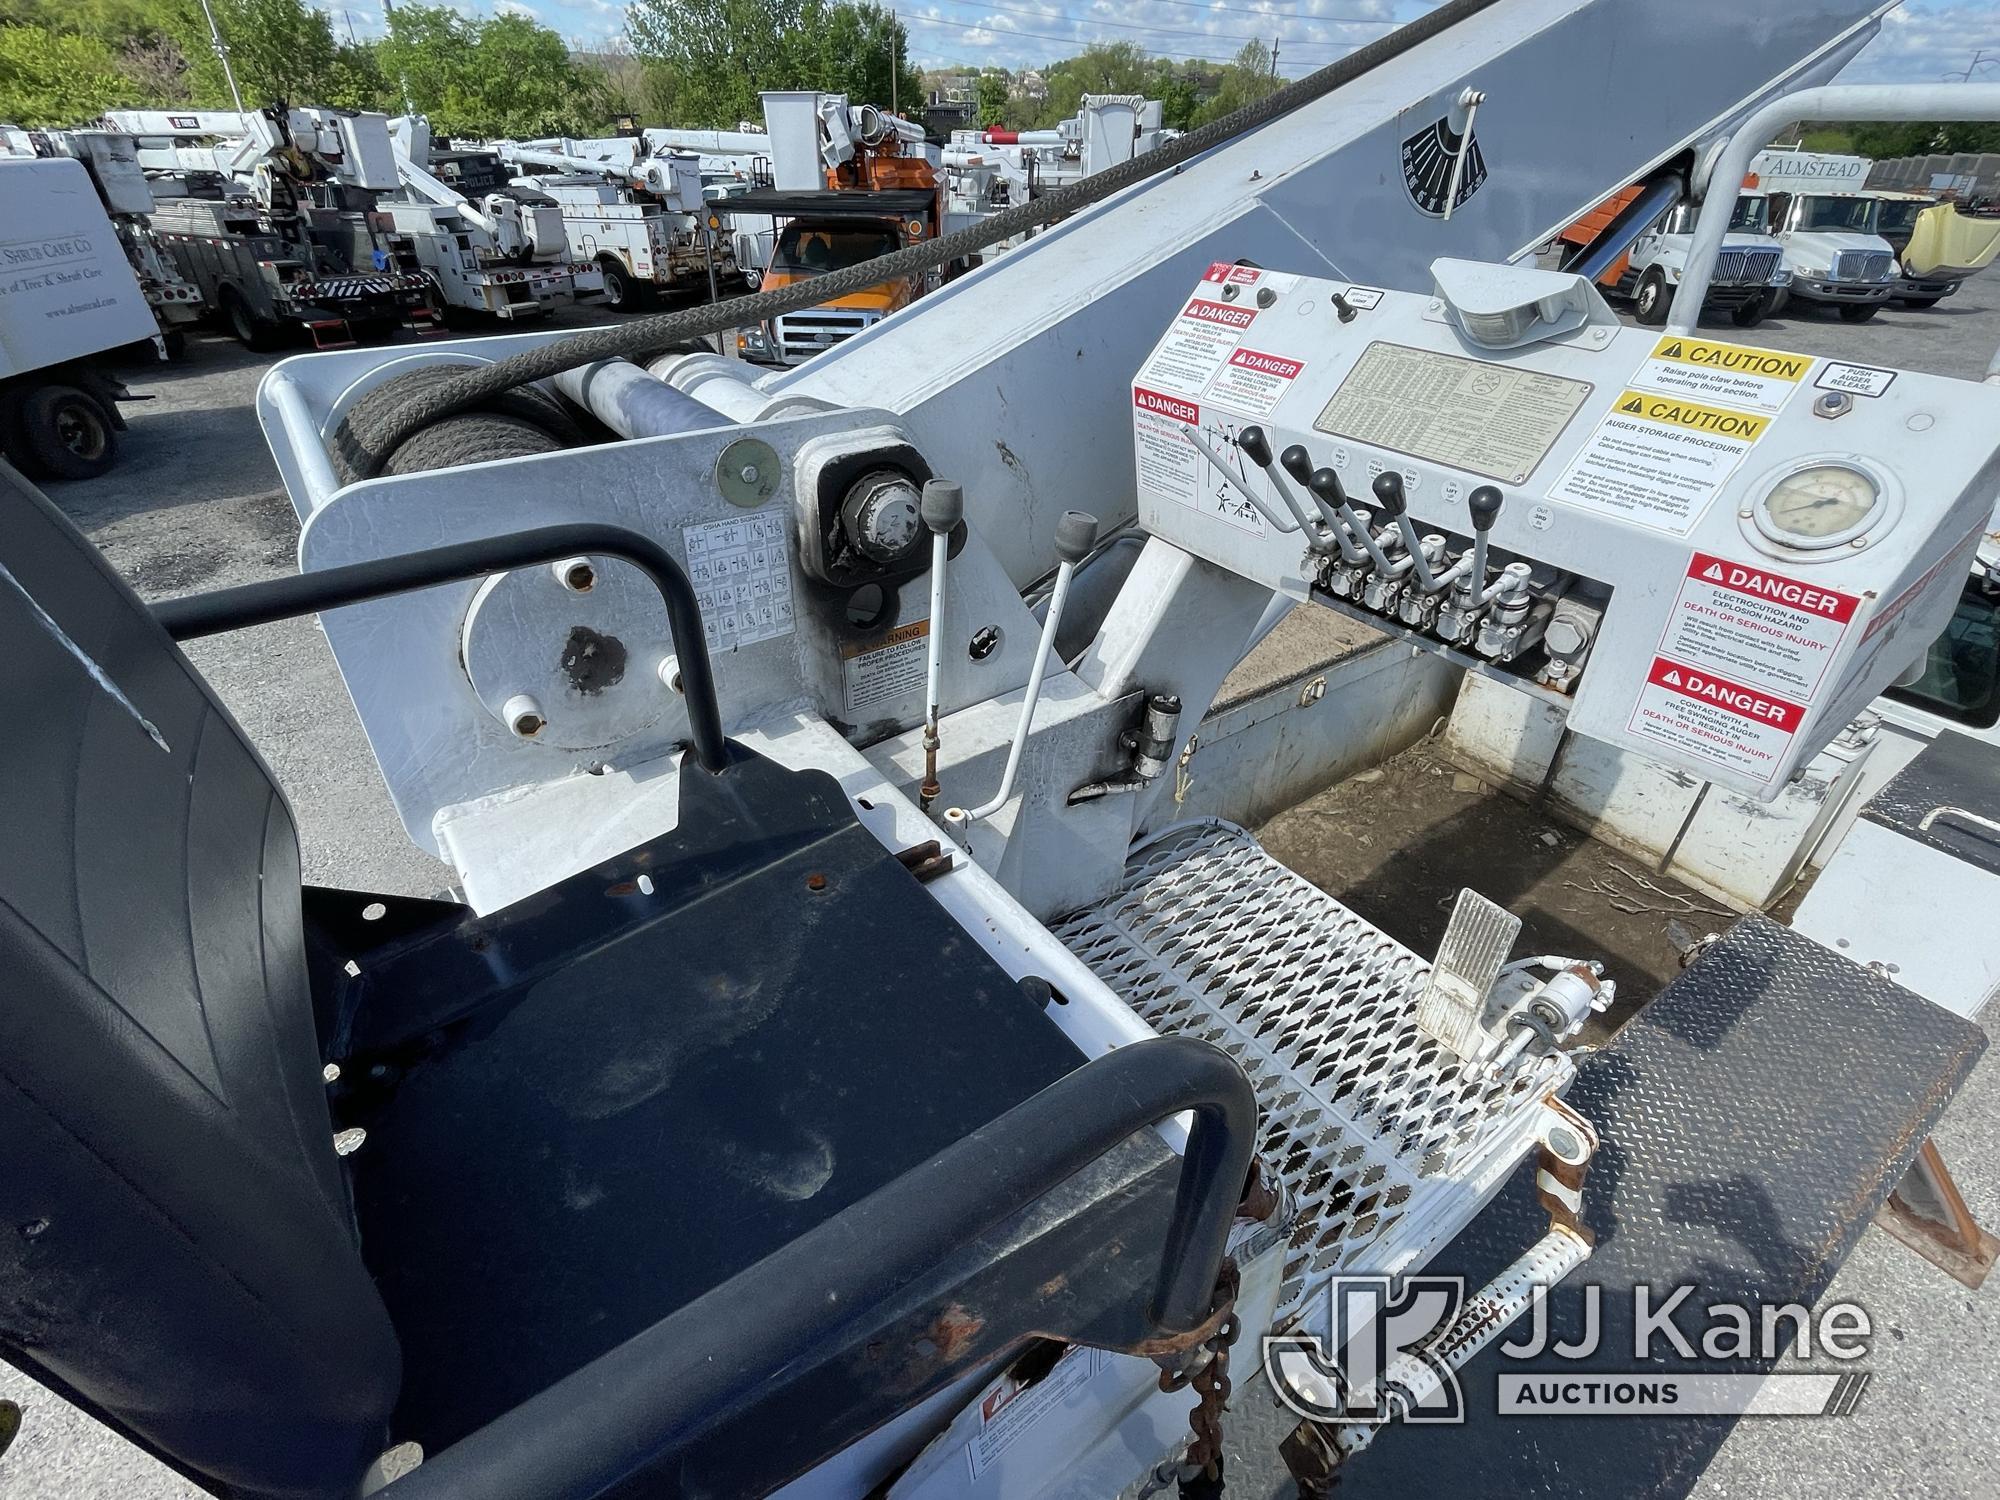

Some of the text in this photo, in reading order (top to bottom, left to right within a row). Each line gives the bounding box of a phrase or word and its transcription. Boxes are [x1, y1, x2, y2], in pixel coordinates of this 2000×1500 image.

[1768, 159, 1861, 177] ALMSTEAD
[464, 174, 496, 188] POLICE
[1198, 305, 1251, 325] DANGER
[1245, 355, 1296, 375] DANGER
[1687, 346, 1801, 377] CAUTION
[1846, 368, 1872, 376] PUSH
[1656, 375, 1759, 398] operating third section.
[1662, 366, 1687, 376] Raise
[1708, 375, 1730, 383] claw
[1731, 378, 1763, 389] before
[1830, 378, 1871, 390] RELEASE
[1839, 374, 1870, 383] AUGER
[1148, 395, 1194, 420] DANGER
[1647, 402, 1758, 436] CAUTION
[1605, 419, 1744, 454] AUGER STORAGE PROCEDURE
[1615, 445, 1639, 455] damage
[1687, 456, 1712, 466] storing.
[1585, 458, 1702, 491] latched before releasing digger control.
[1679, 476, 1715, 489] completely
[1605, 478, 1628, 486] unstore
[1628, 483, 1649, 492] digger
[1669, 494, 1690, 503] speed
[1623, 489, 1645, 498] speeds
[1660, 498, 1681, 508] digger
[703, 522, 720, 531] OSHA
[740, 514, 766, 524] SIGNALS
[1729, 568, 1839, 613] DANGER
[1712, 590, 1809, 624] ELECTROCUTION AND
[1712, 598, 1802, 631] EXPLOSION HAZARD
[1682, 627, 1717, 641] utility lines.
[1684, 601, 1825, 651] DEATH OR SERIOUS INJURY
[1699, 620, 1717, 629] result
[1718, 625, 1733, 634] from
[1735, 632, 1759, 642] contact
[1776, 644, 1798, 655] buried
[858, 650, 885, 662] FAILURE
[896, 640, 921, 650] FOLLOW
[1675, 645, 1698, 656] agency.
[1679, 634, 1710, 648] Determine
[1711, 645, 1725, 654] their
[1726, 650, 1752, 663] location
[1753, 659, 1774, 670] before
[1696, 624, 1714, 634] lines,
[1715, 631, 1744, 643] electrical
[1745, 641, 1766, 651] cables
[1782, 653, 1800, 662] other
[858, 644, 926, 669] PROPER PROCEDURES
[1676, 639, 1700, 651] Contact
[1701, 648, 1737, 664] appropriate
[1739, 661, 1757, 671] utility
[1766, 670, 1808, 687] government
[1680, 698, 1718, 716] CONTACT
[1719, 713, 1741, 725] WITH
[1686, 676, 1787, 722] DANGER
[1665, 701, 1759, 739] FREE SWINGING AUGER
[1677, 713, 1696, 724] WILL
[1697, 720, 1729, 736] RESULT
[1642, 708, 1772, 761] DEATH OR SERIOUS INJURY
[1643, 726, 1665, 737] persons
[1711, 752, 1727, 760] area.
[1645, 721, 1661, 730] Never
[1708, 745, 1726, 754] auger
[1727, 752, 1742, 760] until
